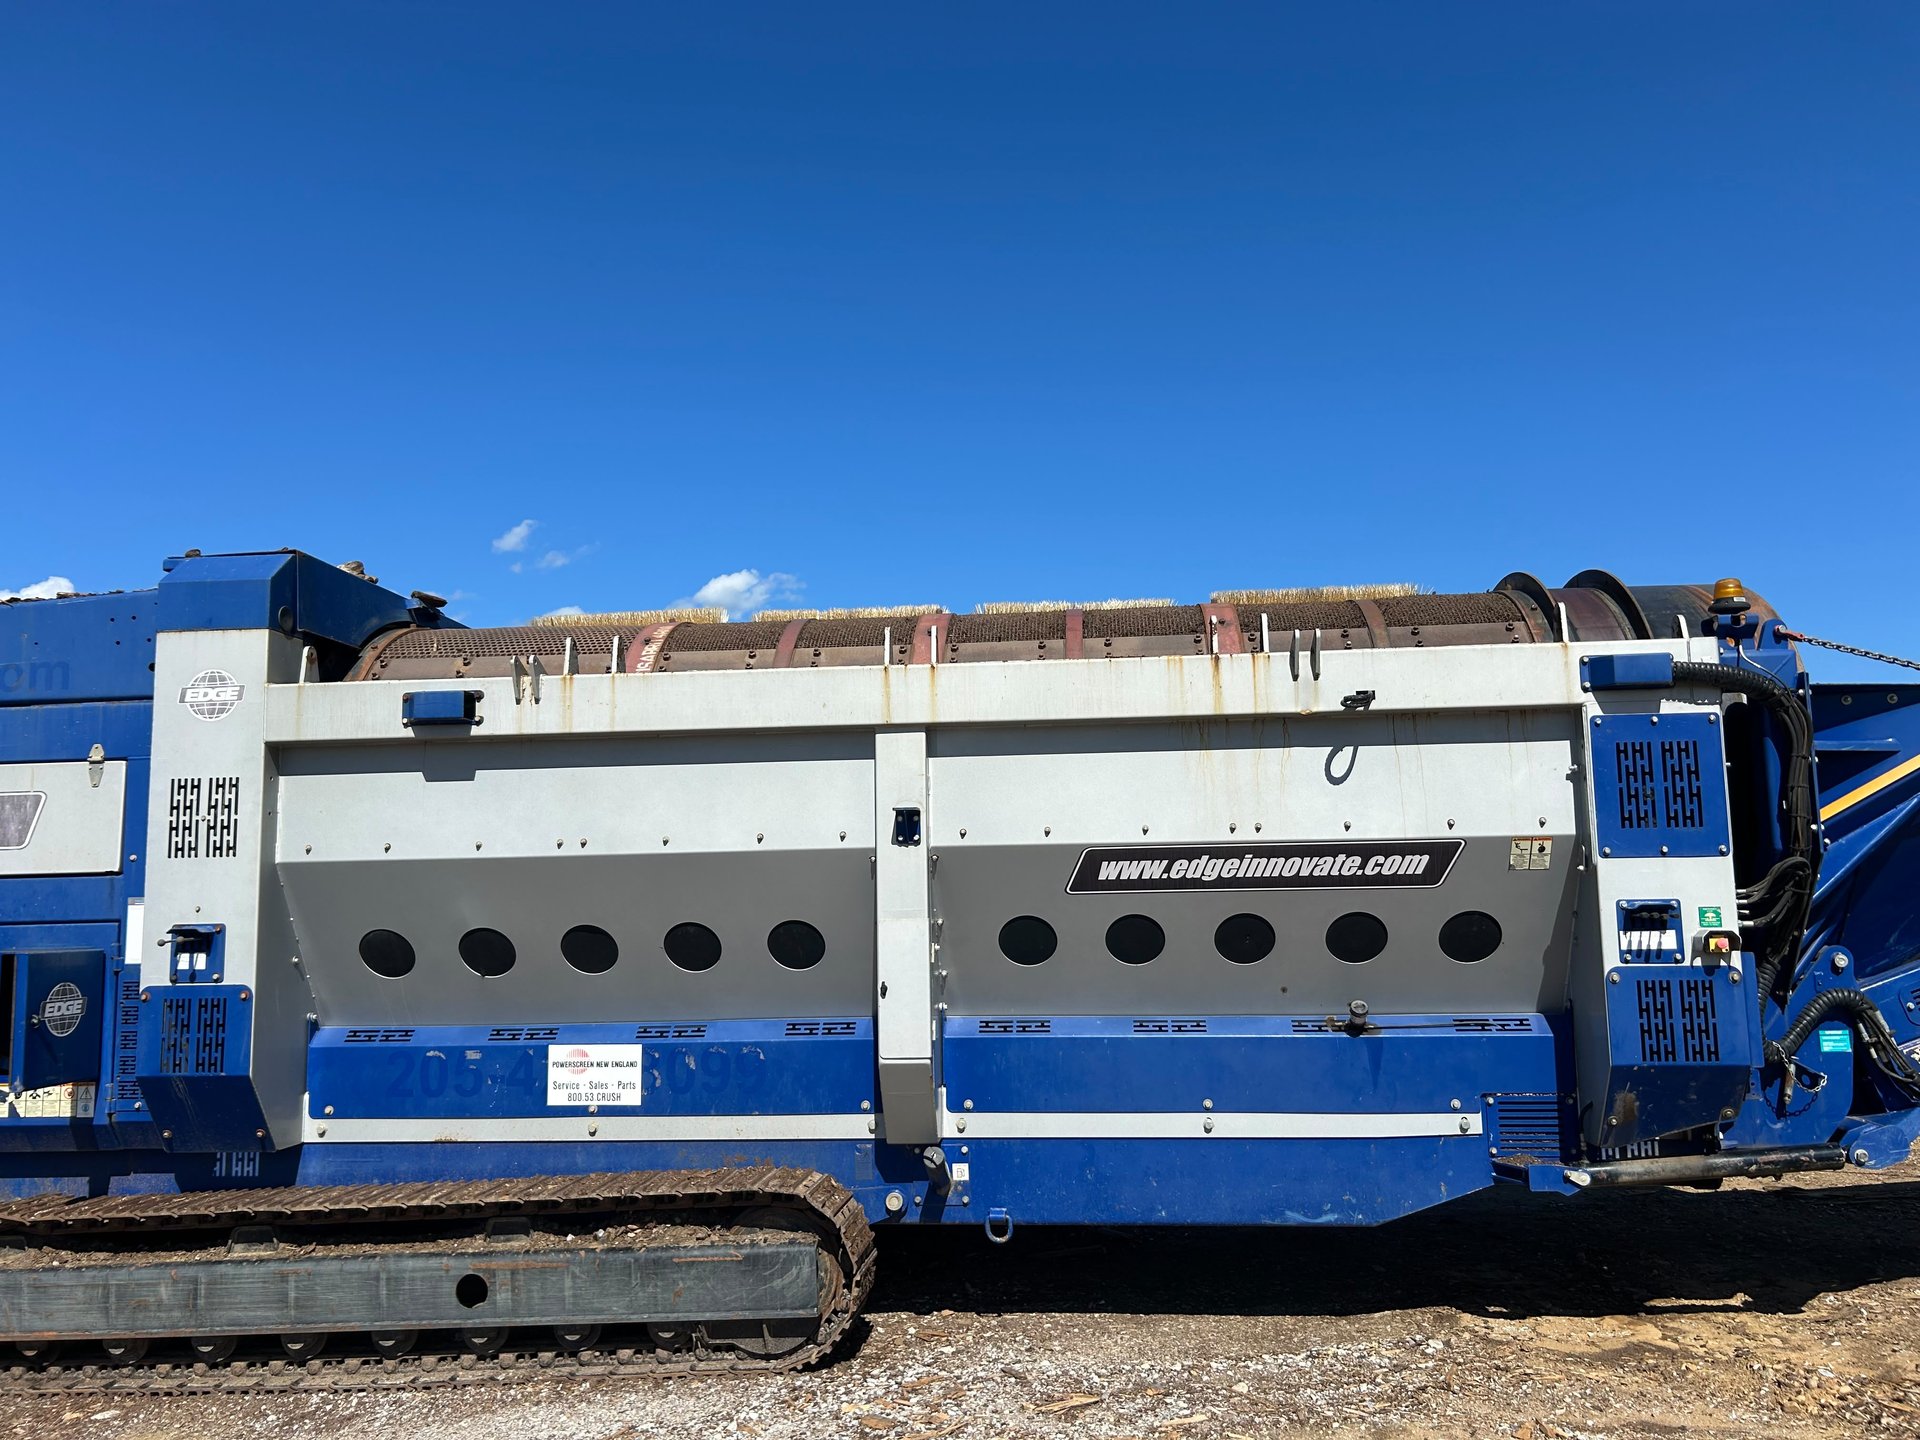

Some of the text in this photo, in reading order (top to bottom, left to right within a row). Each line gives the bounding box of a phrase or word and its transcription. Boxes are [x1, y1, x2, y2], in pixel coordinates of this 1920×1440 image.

[184, 686, 241, 702] EDGE
[1098, 854, 1430, 881] www.edgeinnovate.com
[44, 1000, 83, 1018] EDGE
[552, 1081, 636, 1090] Service Sales Parts
[567, 1092, 621, 1102] 800.53.CRUSH
